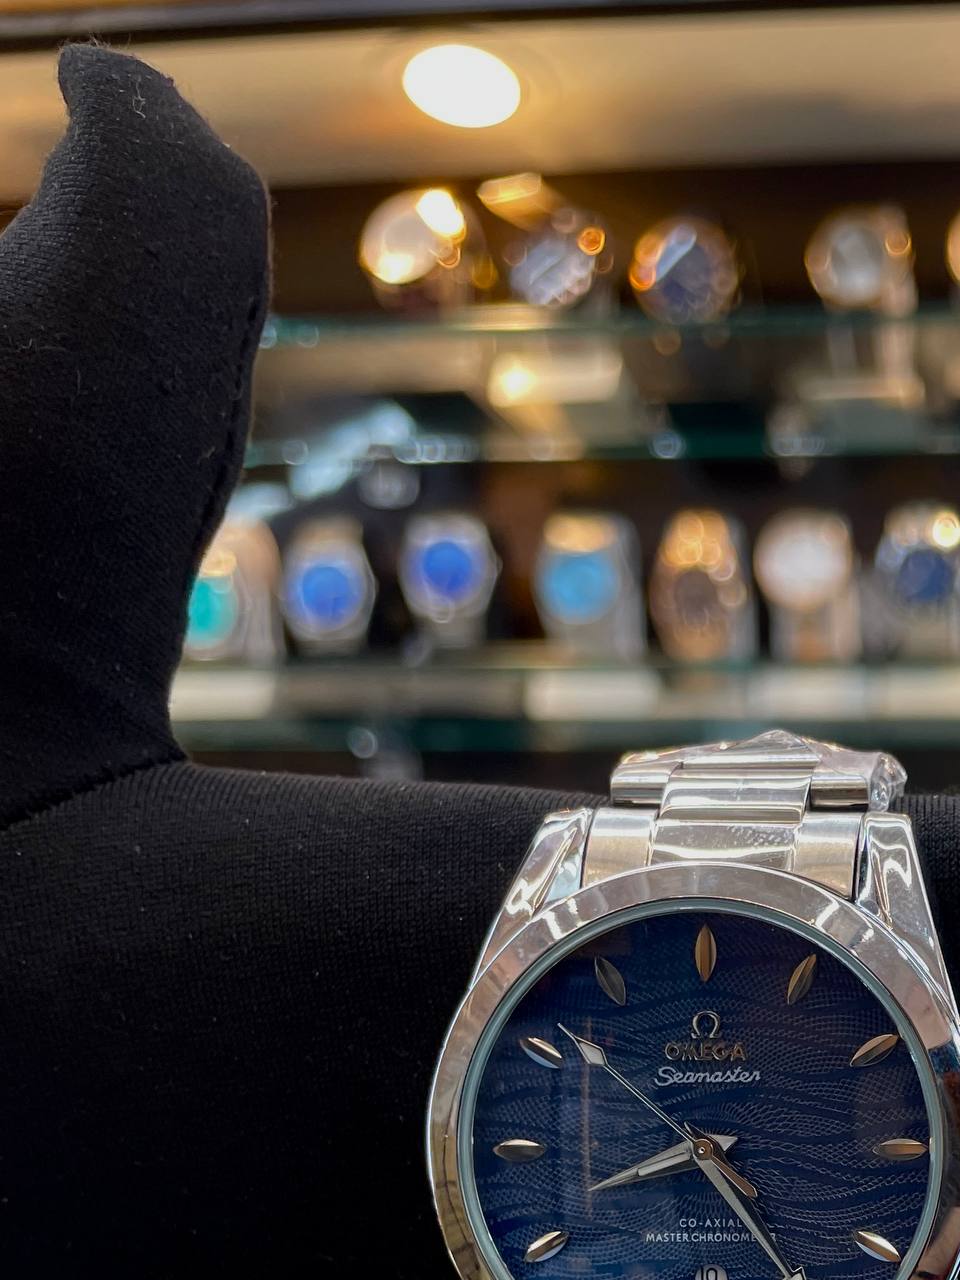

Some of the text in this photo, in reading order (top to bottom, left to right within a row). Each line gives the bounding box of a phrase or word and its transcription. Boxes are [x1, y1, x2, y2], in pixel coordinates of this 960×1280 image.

[664, 1042, 747, 1062] OMEGA
[654, 1066, 761, 1087] Seamaster
[679, 1218, 743, 1228] CO-AXIAL
[646, 1232, 776, 1243] MASTER CHRONOMER
